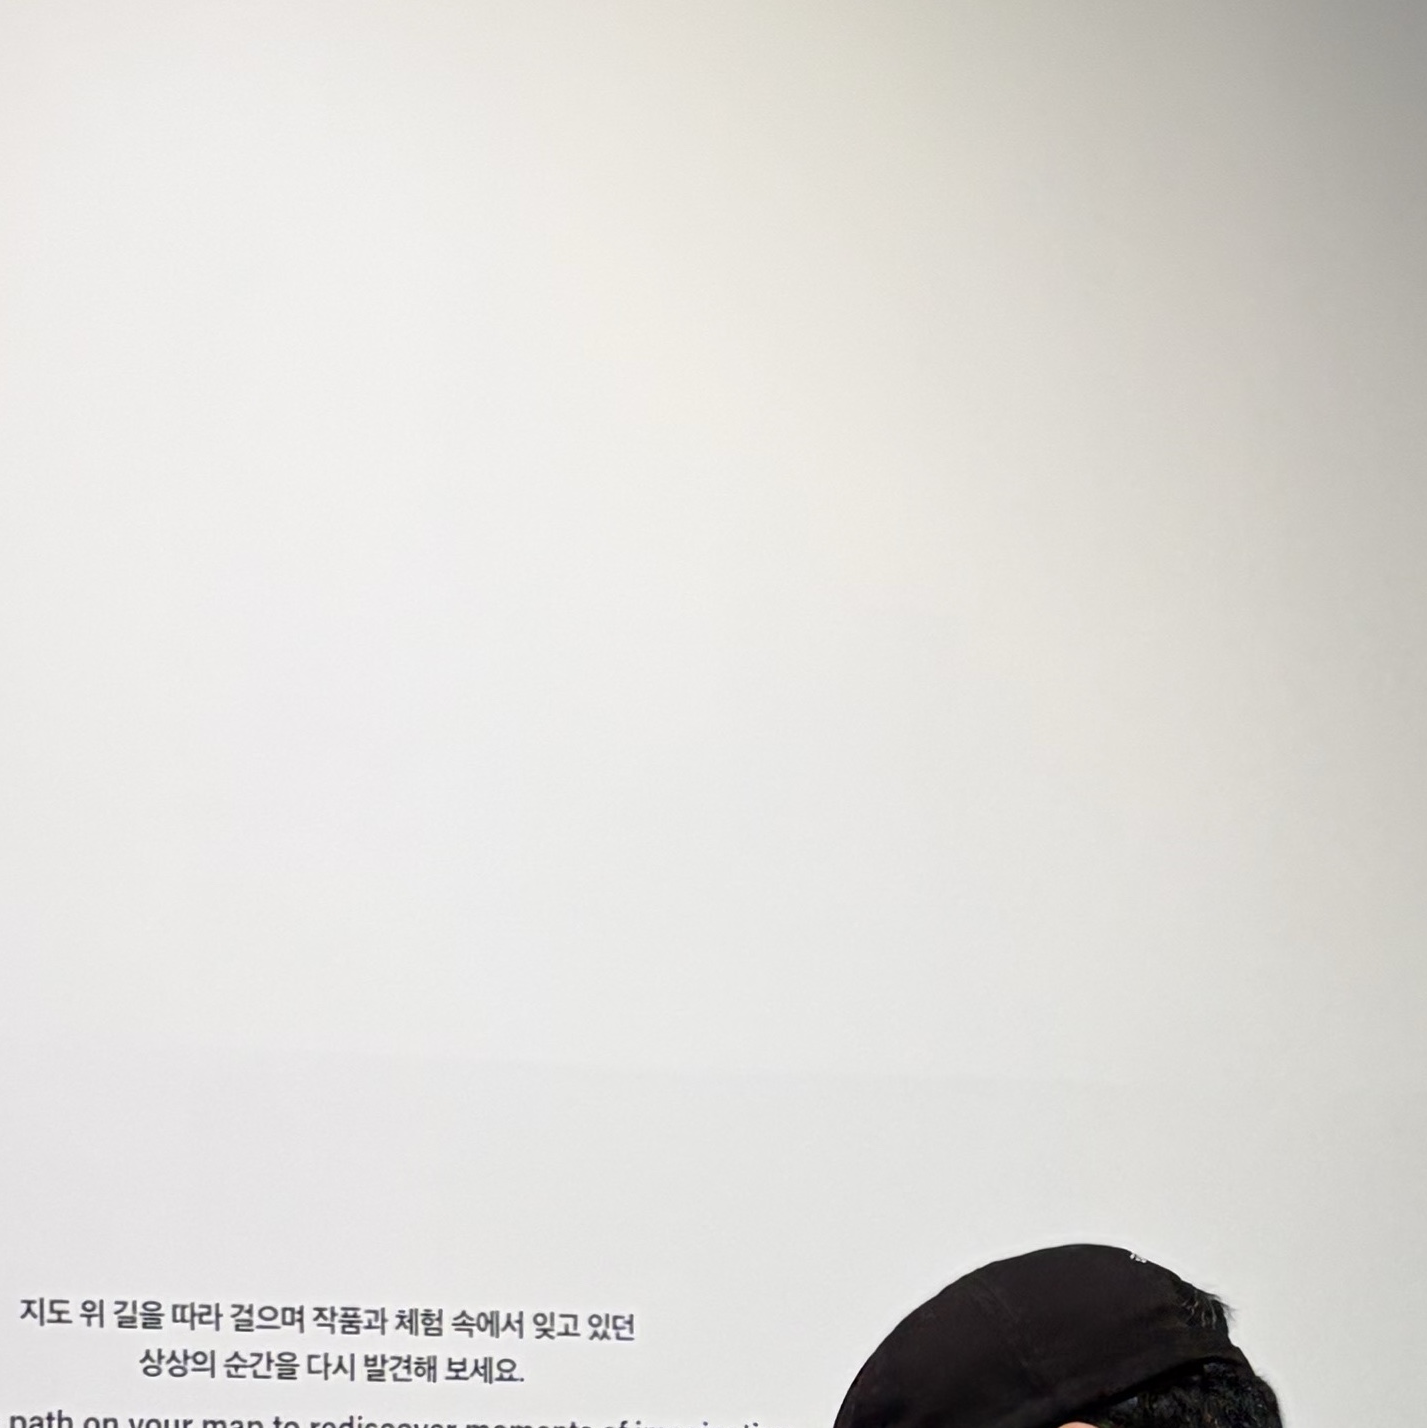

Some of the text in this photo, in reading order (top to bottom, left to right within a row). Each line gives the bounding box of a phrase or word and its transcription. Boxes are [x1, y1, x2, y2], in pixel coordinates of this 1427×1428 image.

[19, 1297, 635, 1342] 지도 위 길을 따라 걸으며 작품과 체험 속에서 잊고 있던
[138, 1347, 525, 1385] 상상의 순간을 다시 발견해 보세요.
